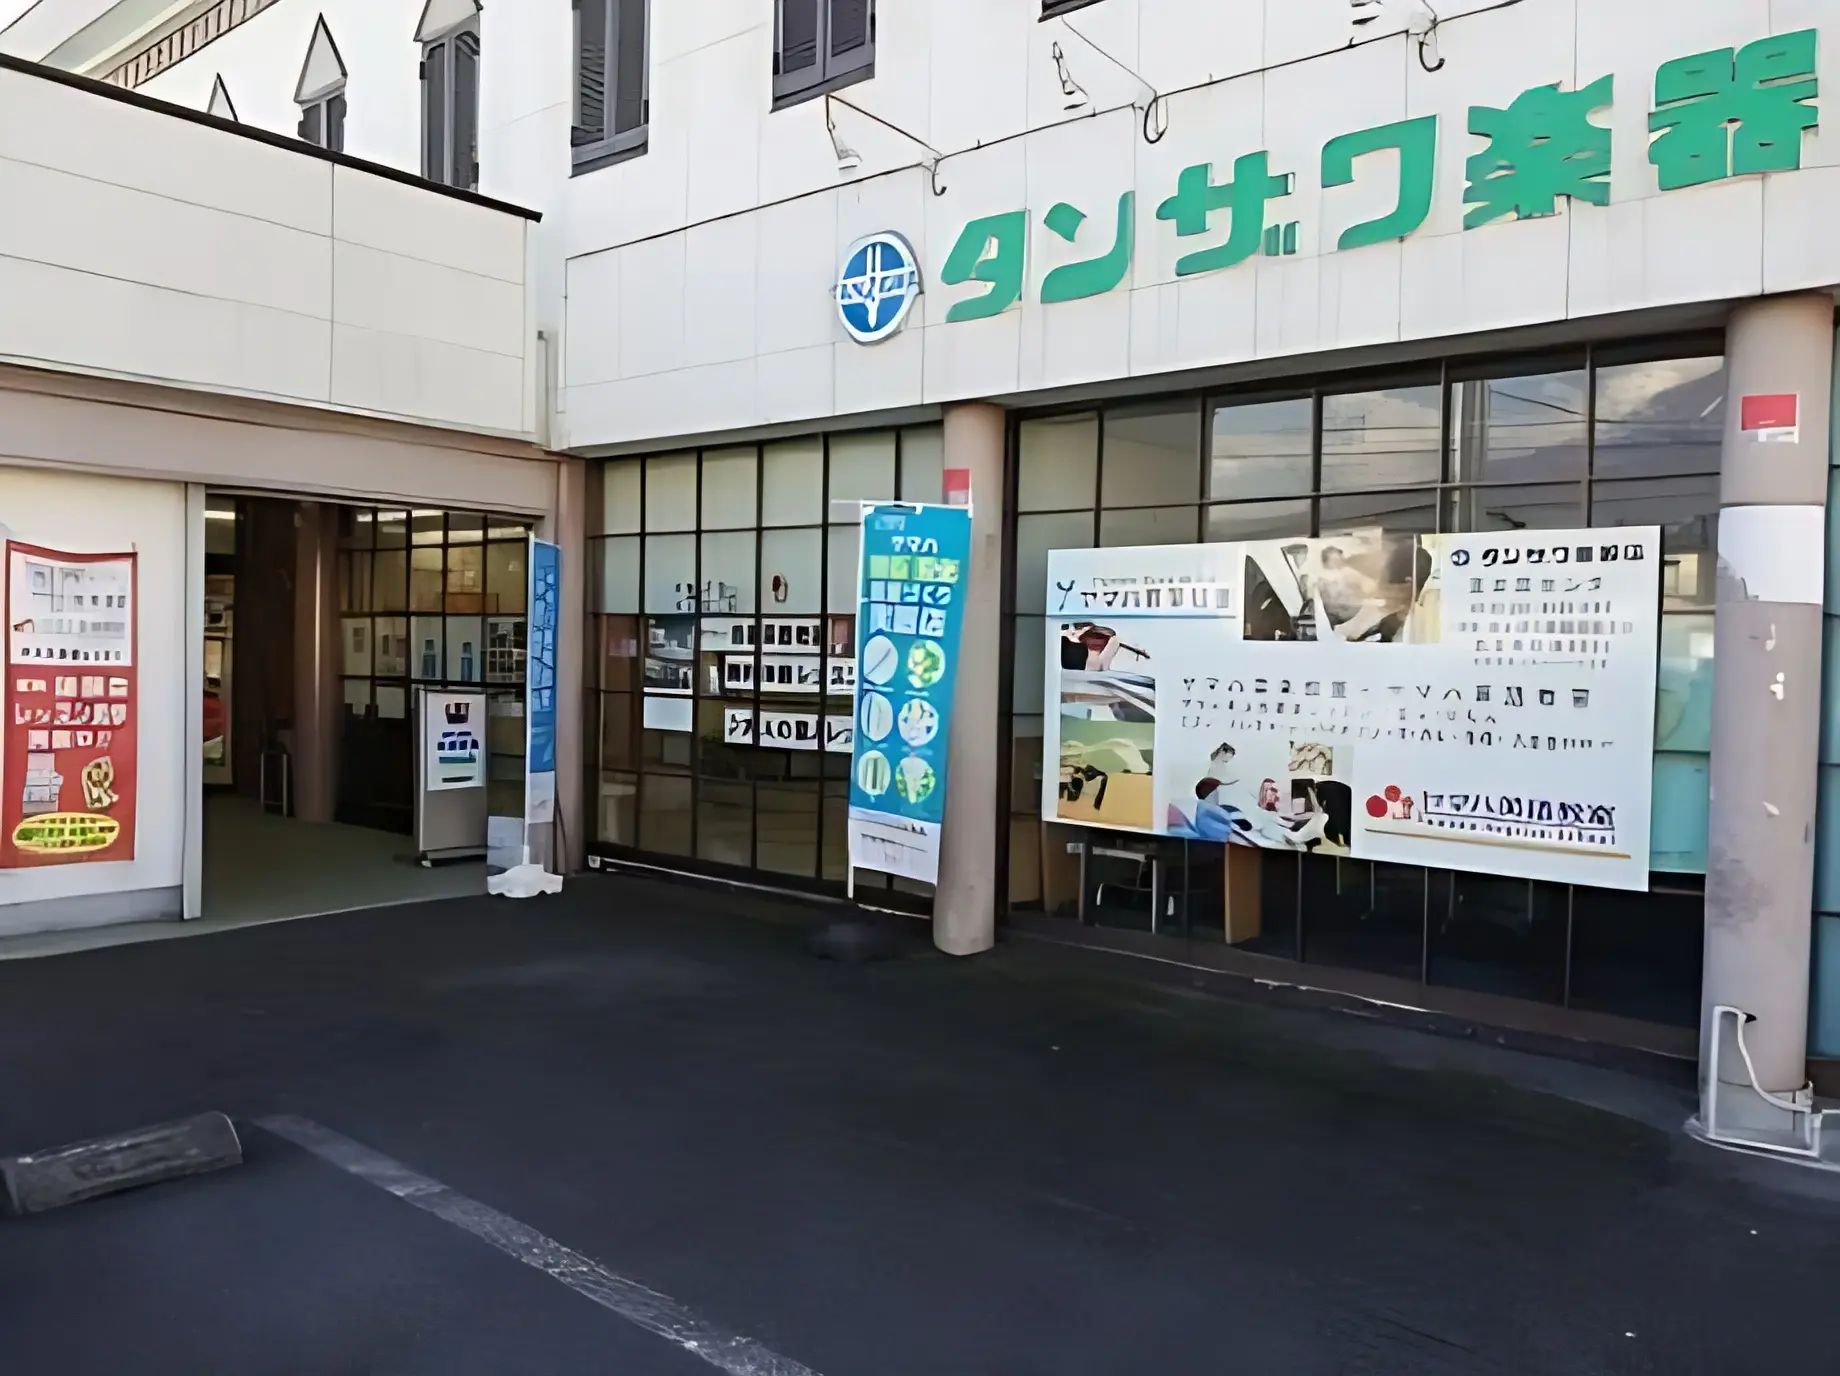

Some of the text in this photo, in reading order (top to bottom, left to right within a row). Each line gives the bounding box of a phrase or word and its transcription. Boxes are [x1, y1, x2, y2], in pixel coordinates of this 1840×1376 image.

[942, 28, 1819, 322] タンザワ楽器
